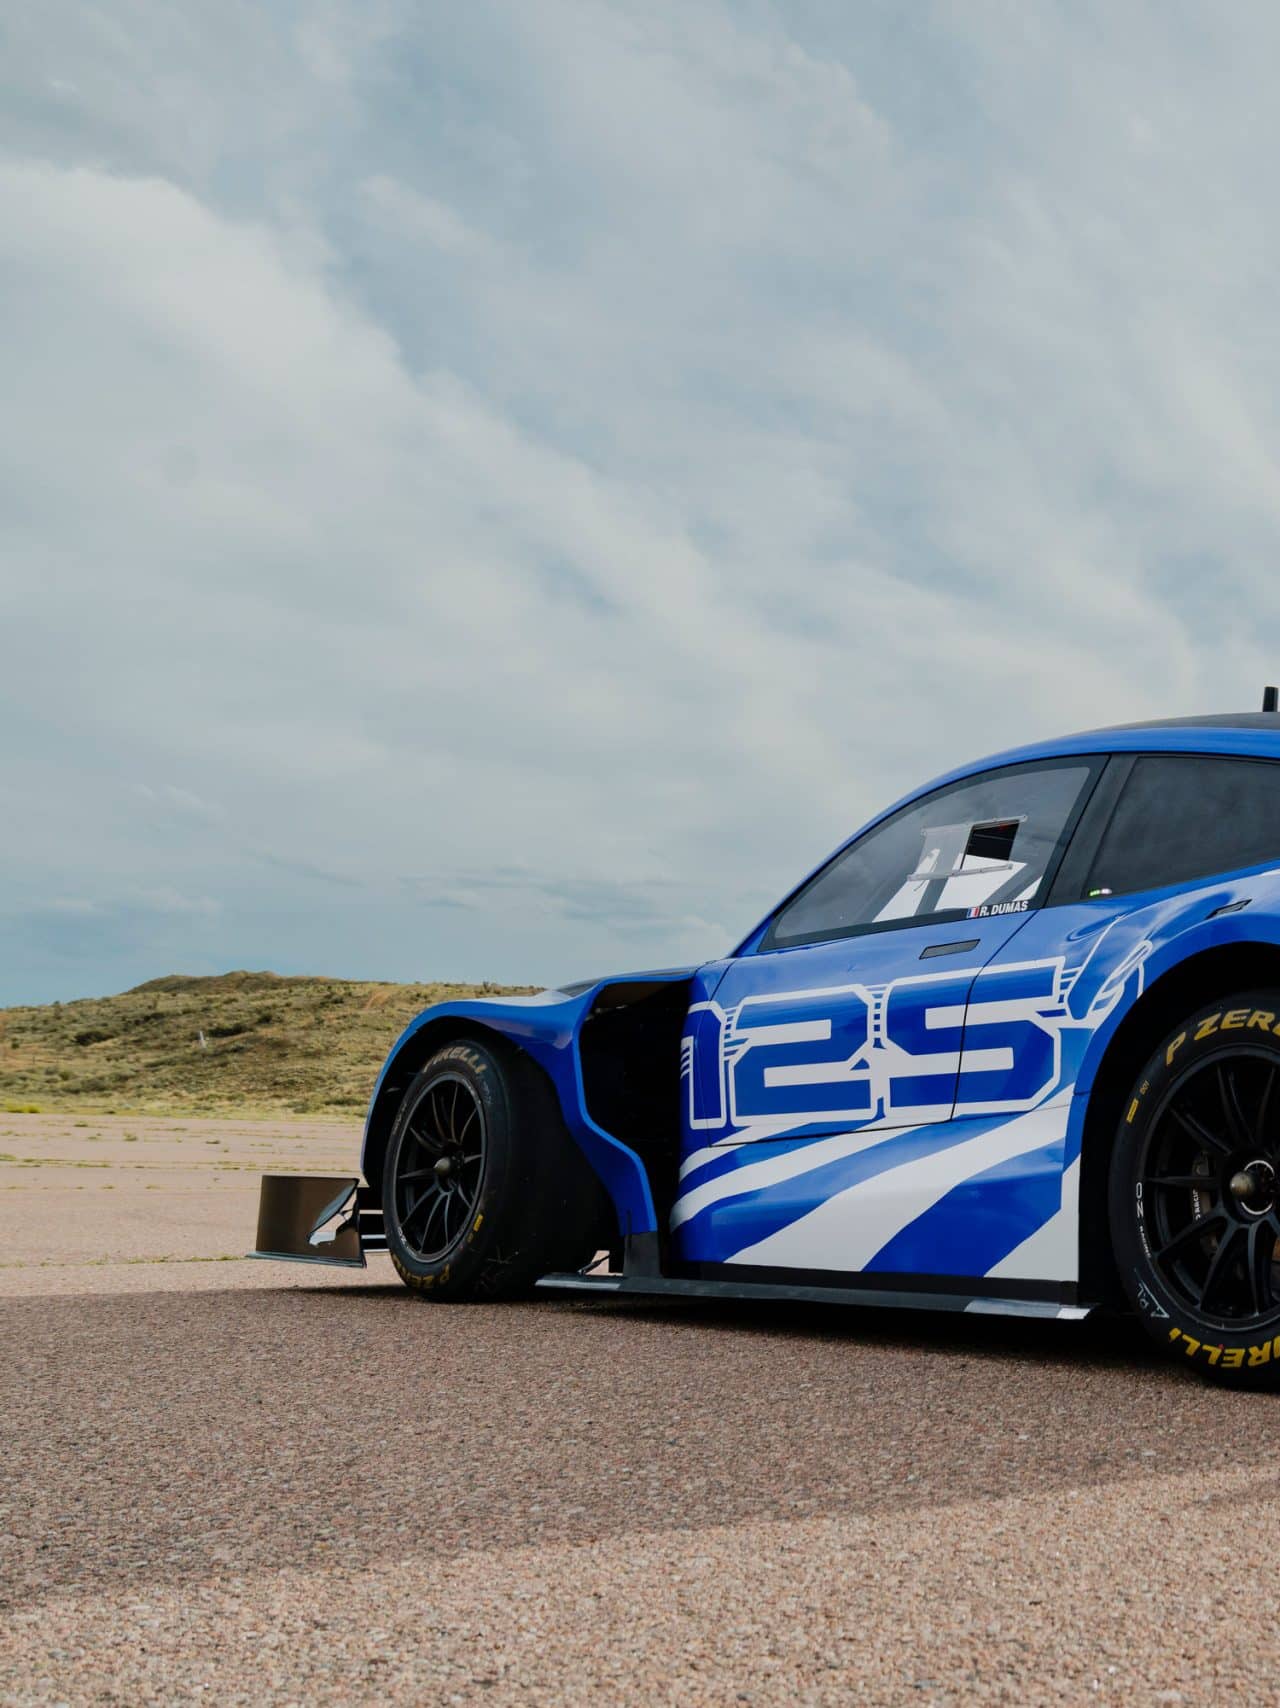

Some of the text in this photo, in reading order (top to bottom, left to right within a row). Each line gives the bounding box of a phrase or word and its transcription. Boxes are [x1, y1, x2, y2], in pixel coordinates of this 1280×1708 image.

[979, 900, 1029, 917] R. DUMAS
[1166, 1031, 1186, 1066] P
